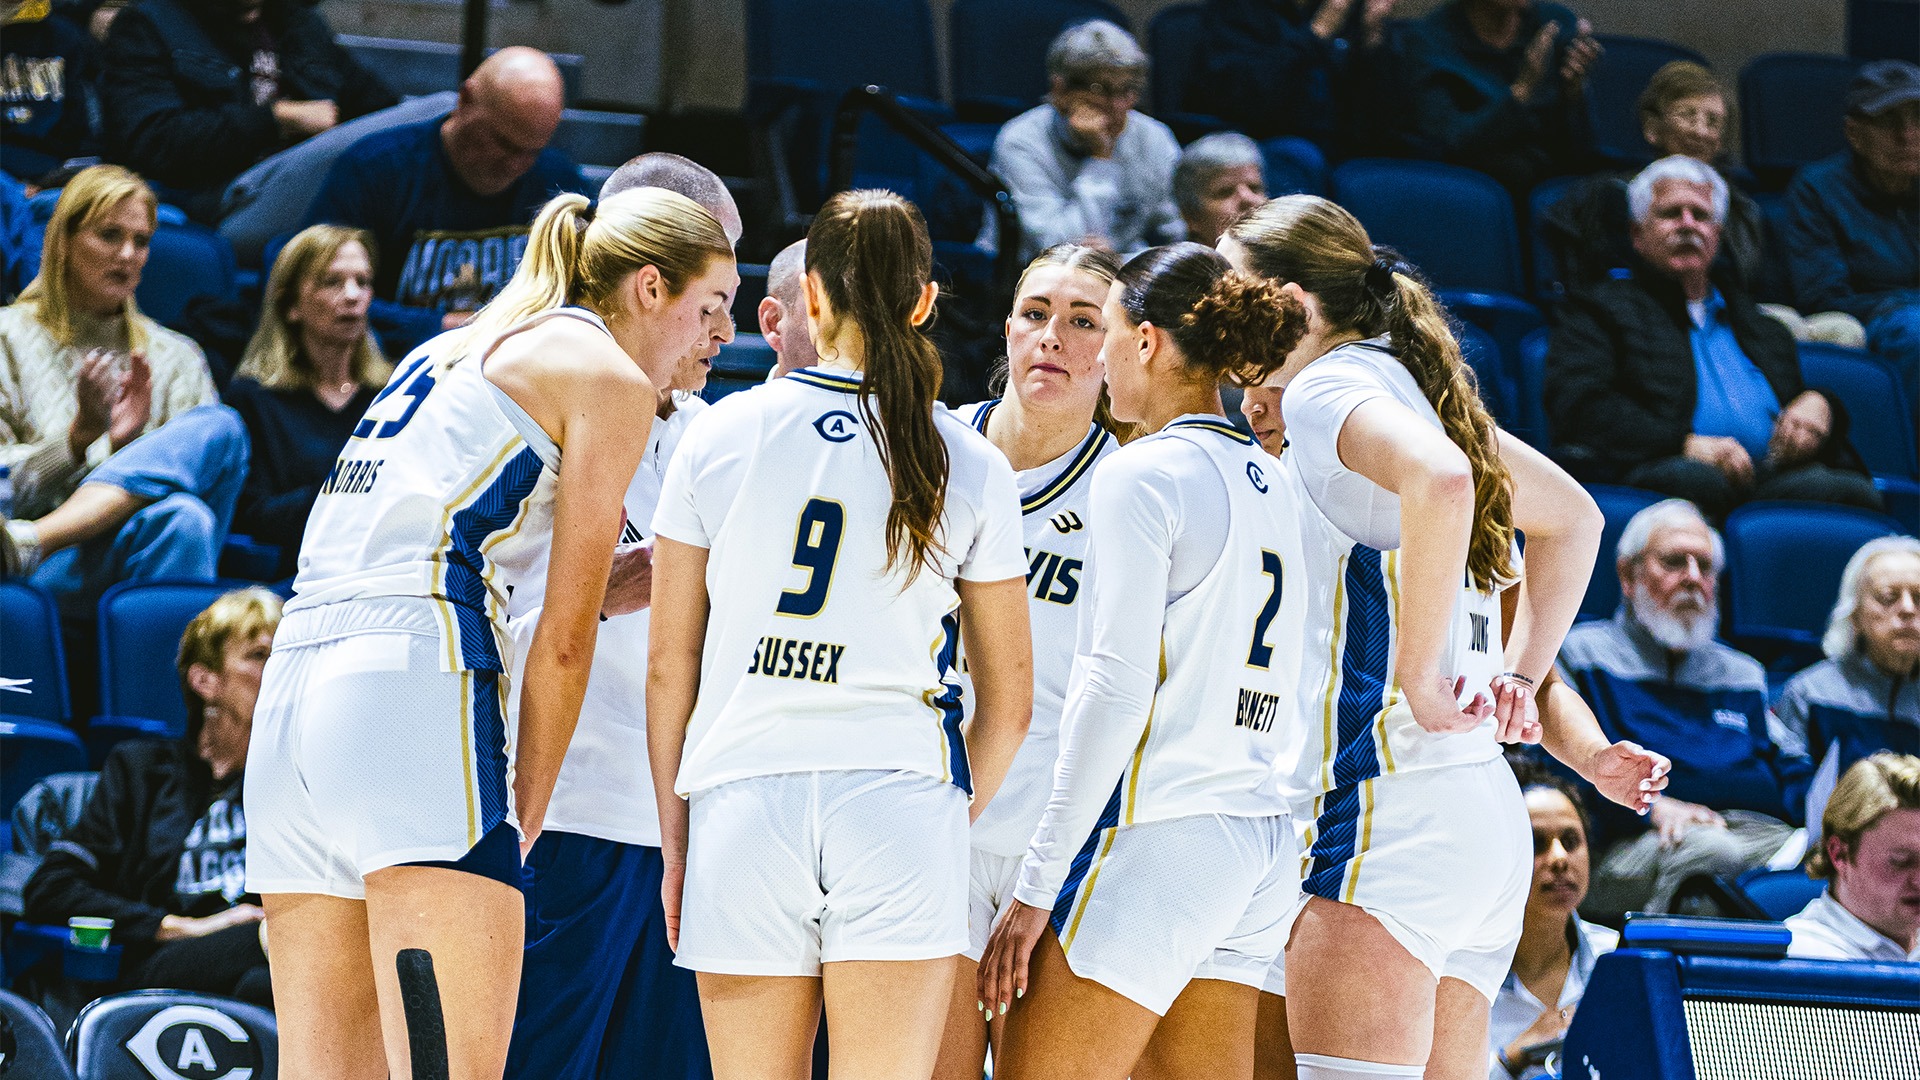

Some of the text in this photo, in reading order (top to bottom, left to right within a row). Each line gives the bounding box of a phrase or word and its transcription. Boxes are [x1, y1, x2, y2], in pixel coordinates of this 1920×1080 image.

[351, 355, 437, 441] 25
[774, 495, 848, 620] 9
[1023, 547, 1083, 606] VIS
[1244, 546, 1286, 672] 2
[748, 635, 847, 685] SUSSEX
